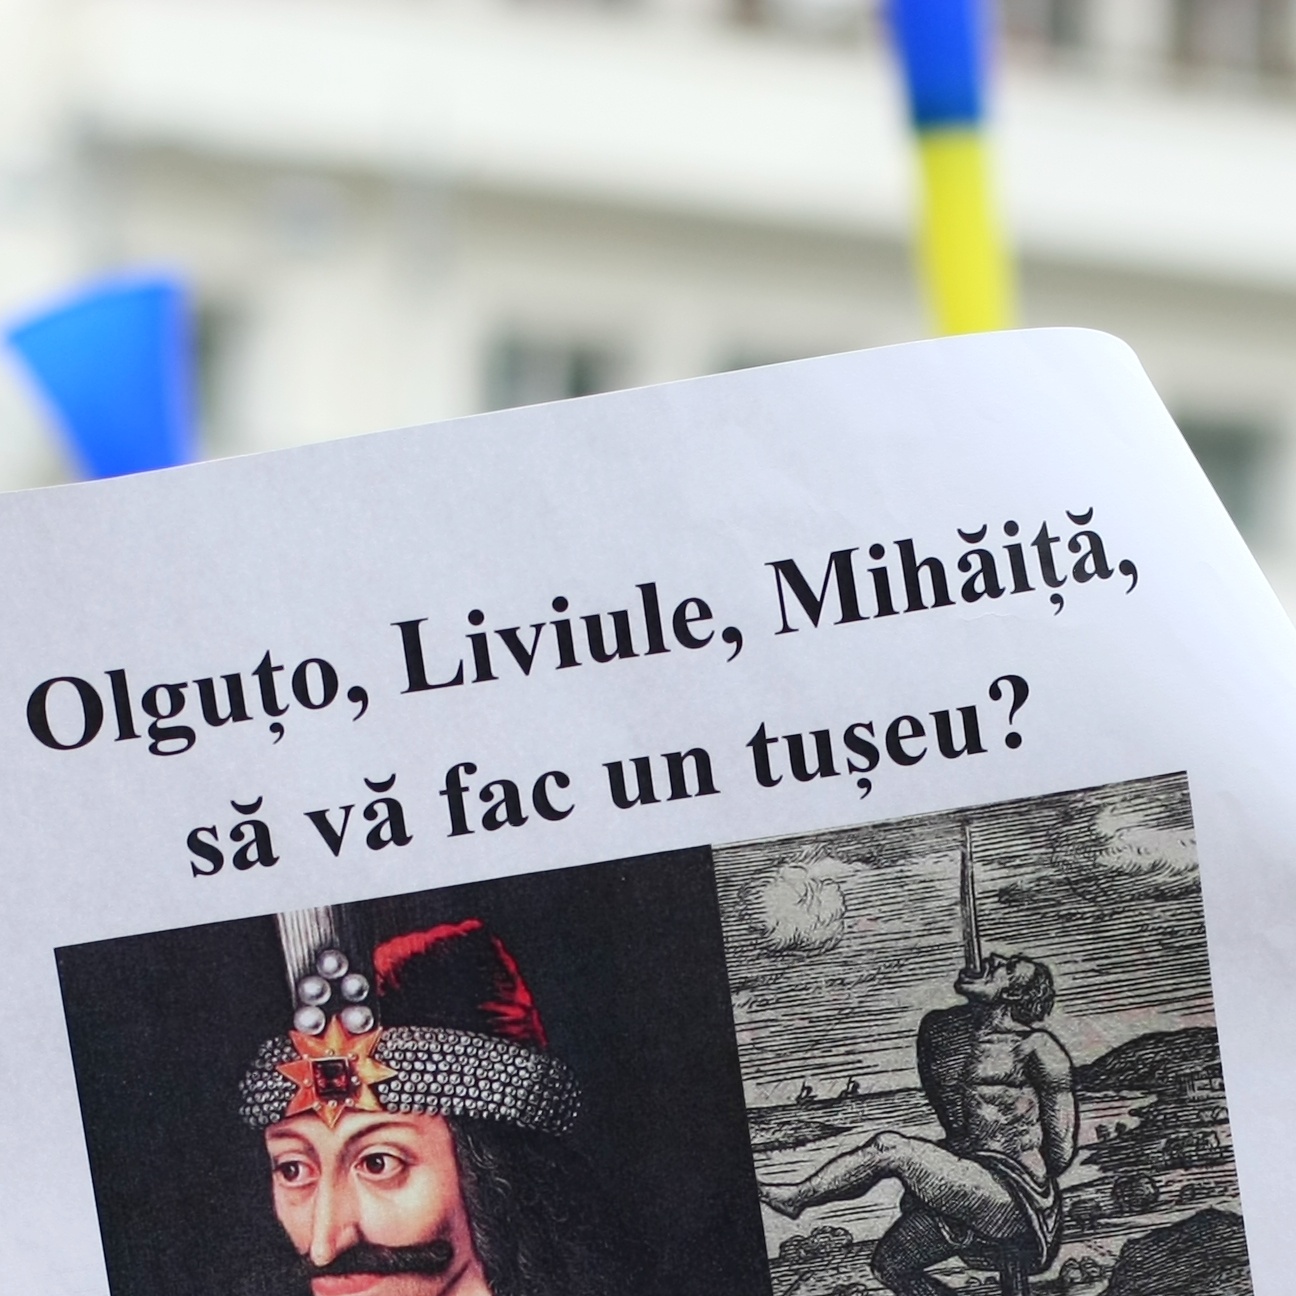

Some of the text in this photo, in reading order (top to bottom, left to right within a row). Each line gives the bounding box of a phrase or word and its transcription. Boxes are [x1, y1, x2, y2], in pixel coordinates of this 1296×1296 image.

[26, 506, 1138, 757] Olguțo, Liviule, Mihăiță,
[186, 674, 1030, 878] să vă fac un tușeu?
